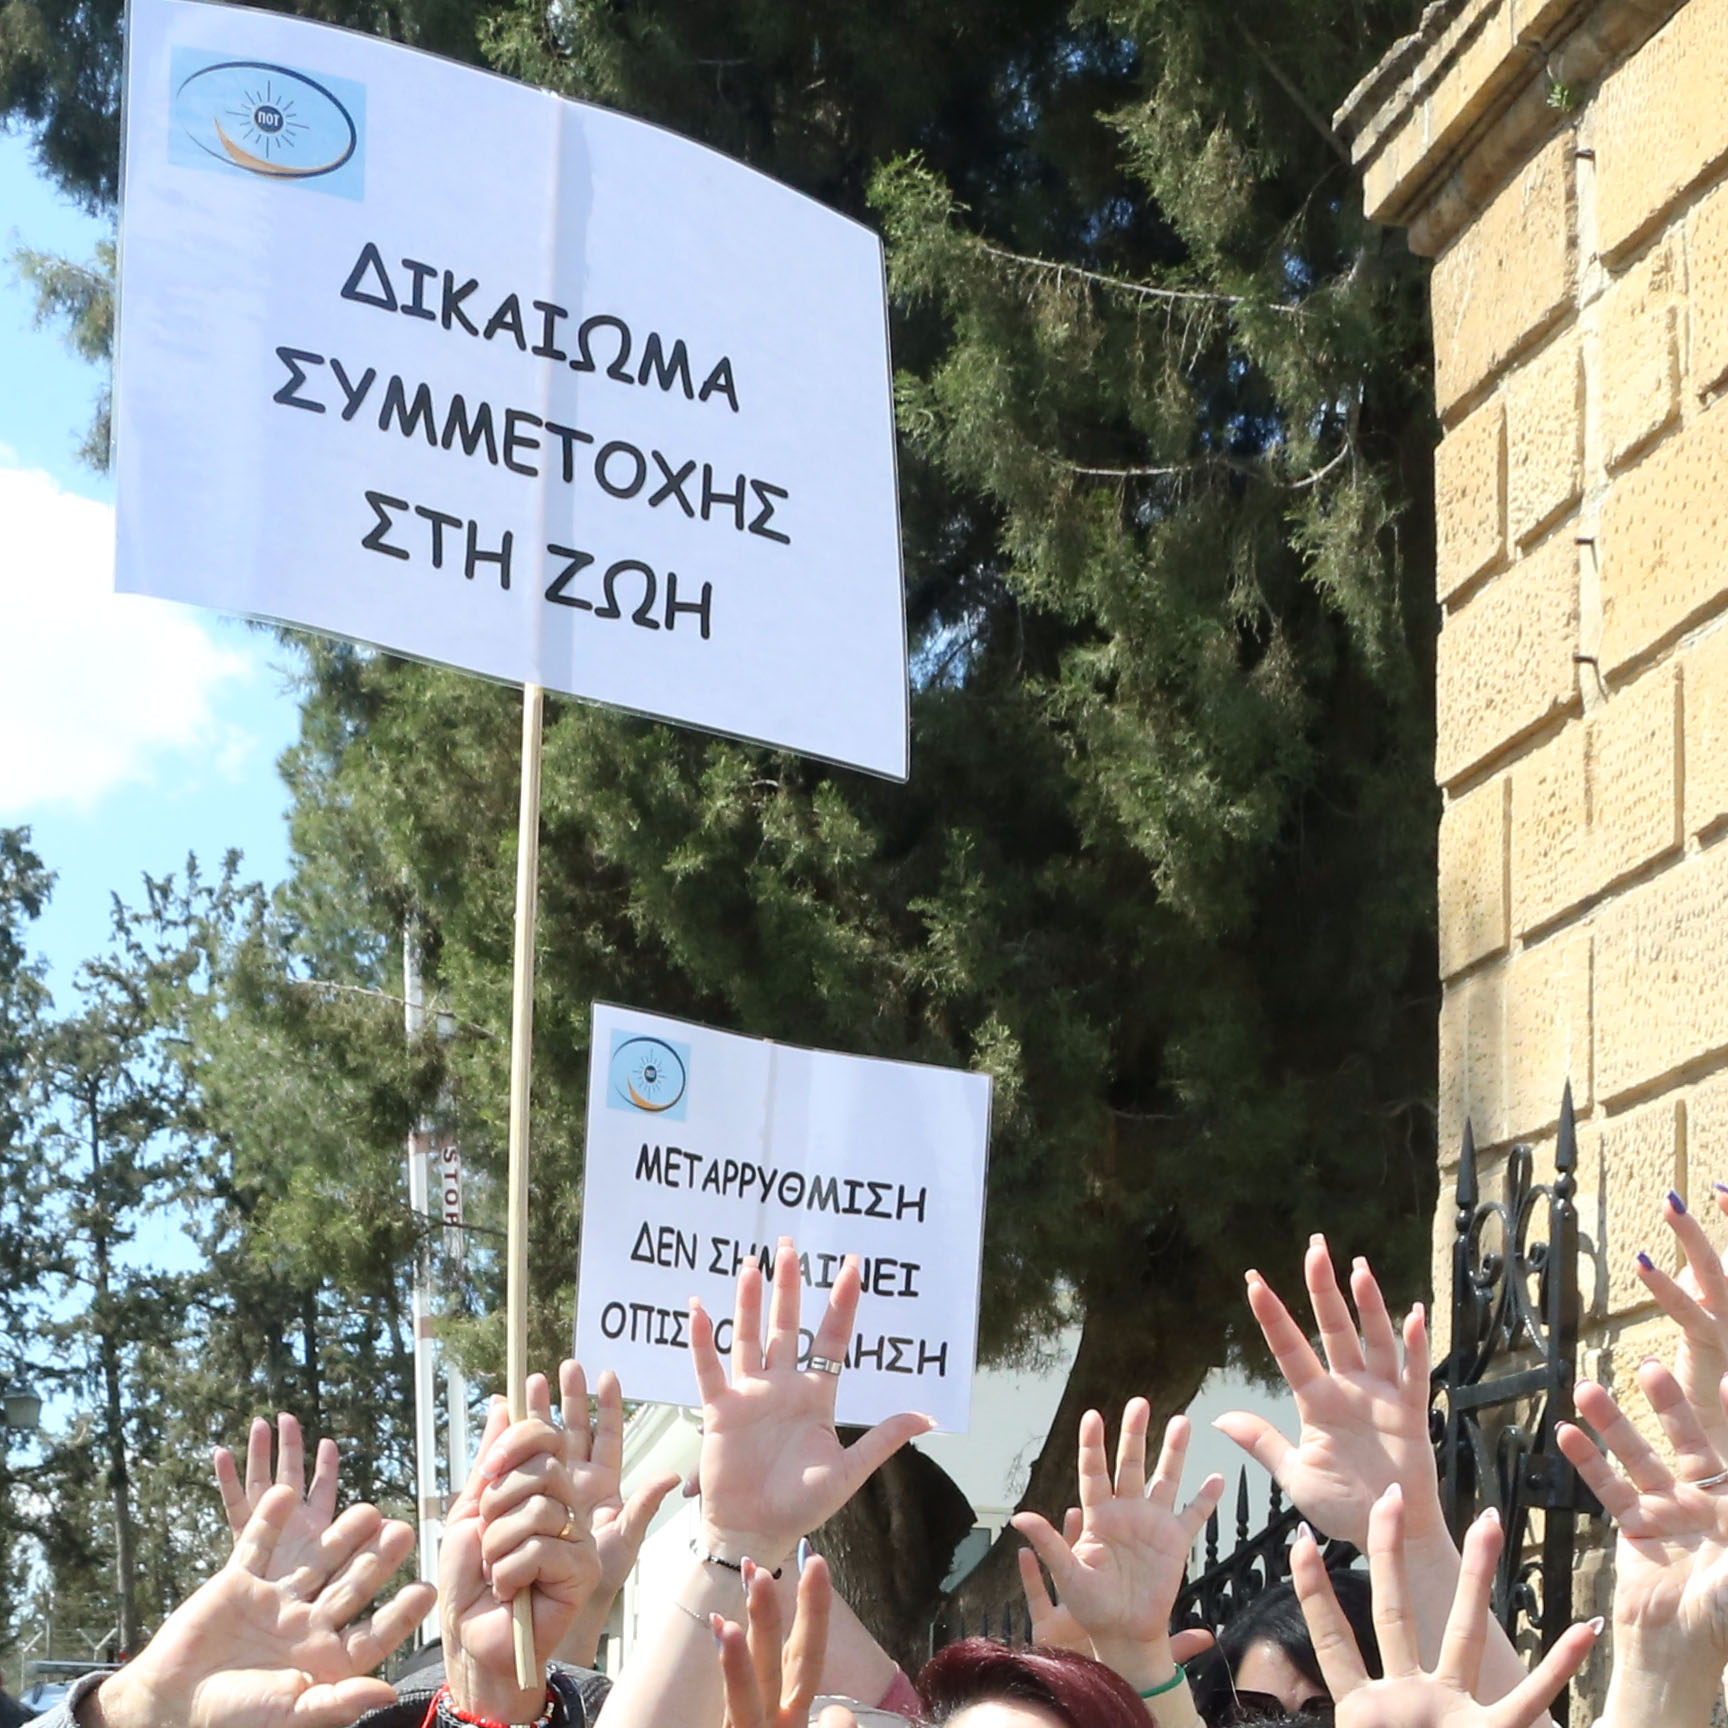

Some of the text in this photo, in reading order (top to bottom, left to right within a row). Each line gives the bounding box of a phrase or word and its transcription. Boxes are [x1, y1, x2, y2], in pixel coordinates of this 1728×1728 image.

[258, 111, 280, 127] ΠΟΤ
[339, 241, 740, 413] ΔΙΚΑΙΩΜΑ
[272, 346, 791, 546] ΣΥΜΜΕΤΟΧΗΣ
[361, 490, 713, 640] ΣΤΗ ΖΩΗ
[635, 1143, 928, 1223] ΜΕΤΑΡΡΥΘΜΙΣΗ
[630, 1221, 698, 1271] ΔΕΝ
